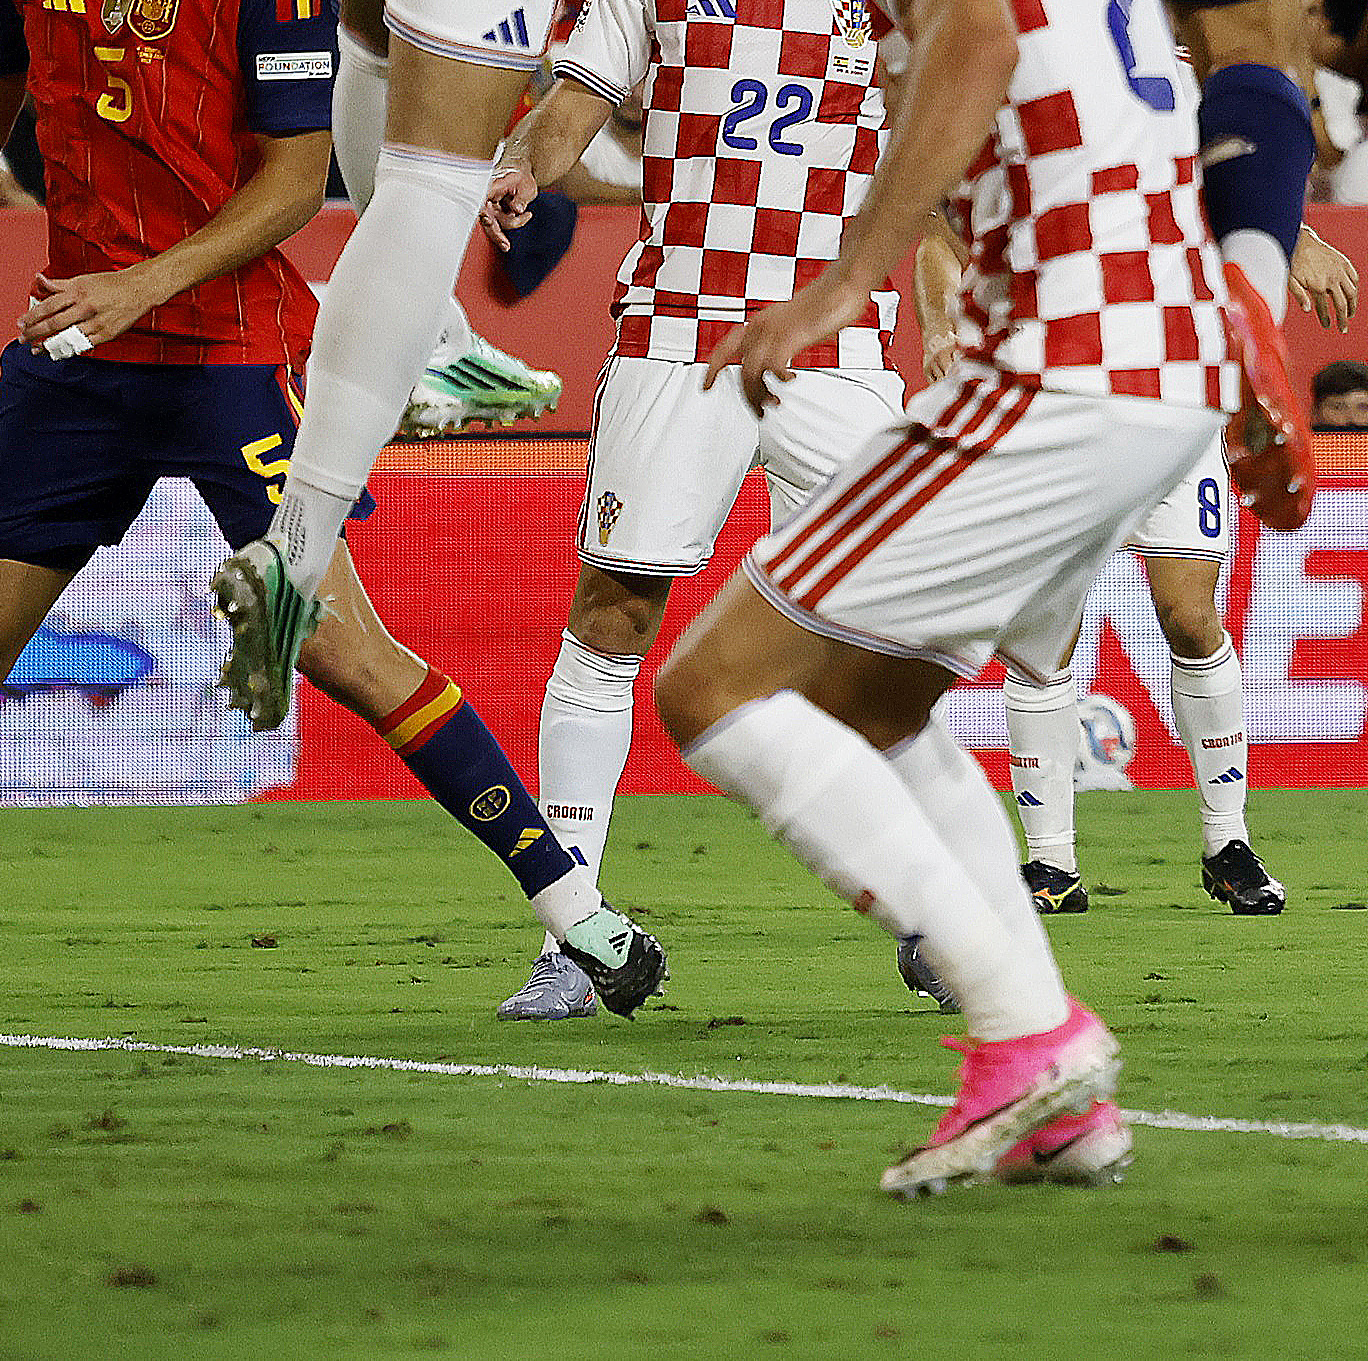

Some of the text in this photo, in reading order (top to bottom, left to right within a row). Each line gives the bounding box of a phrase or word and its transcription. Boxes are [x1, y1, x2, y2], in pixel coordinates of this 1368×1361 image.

[93, 45, 133, 124] 5
[258, 60, 330, 71] FOUNDATION
[722, 78, 814, 156] 22
[239, 432, 292, 506] 5
[1198, 478, 1221, 539] 8
[546, 804, 594, 822] CROATIA
